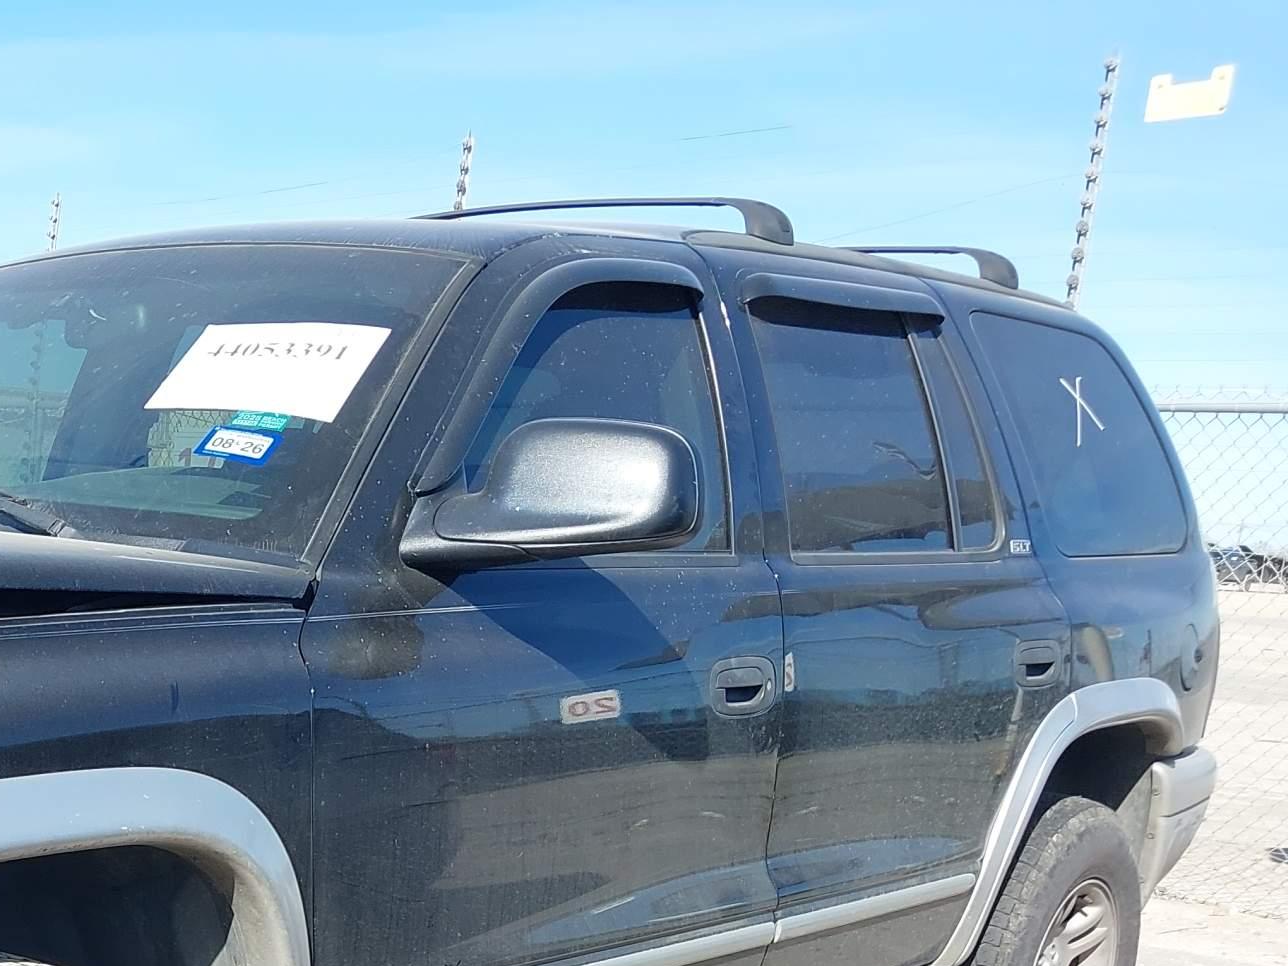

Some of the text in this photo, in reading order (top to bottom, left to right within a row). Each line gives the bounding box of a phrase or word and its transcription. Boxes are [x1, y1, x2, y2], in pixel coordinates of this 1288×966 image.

[208, 342, 349, 360] 44053391
[211, 437, 235, 449] 08
[240, 441, 265, 454] 26
